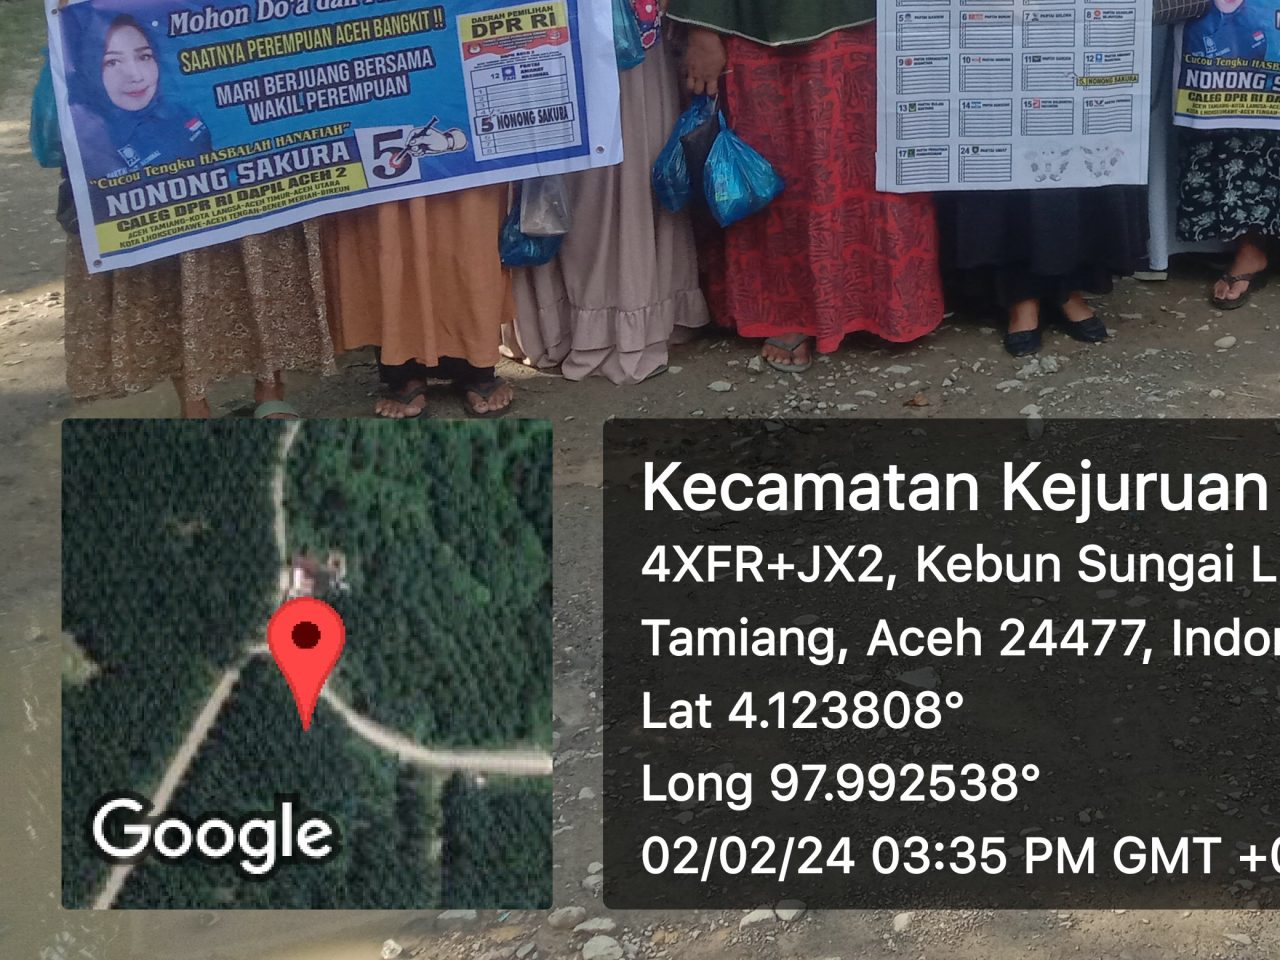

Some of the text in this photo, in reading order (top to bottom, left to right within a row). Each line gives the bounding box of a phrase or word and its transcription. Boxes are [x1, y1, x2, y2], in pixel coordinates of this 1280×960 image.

[169, 6, 249, 36] Mohon
[472, 5, 553, 24] DAERAH PEMILIHAN
[472, 12, 557, 38] DPR RI
[180, 46, 246, 73] SAATNYA
[248, 29, 332, 58] PEREMPUAN
[335, 21, 374, 44] ACEH
[376, 10, 430, 38] BANGKIT
[216, 48, 433, 107] MARI BERJUANG BERSAMA
[1186, 69, 1266, 90] NONONG
[249, 75, 409, 123] WAKIL PEREMPUAN
[1188, 92, 1221, 102] CALEG
[1224, 94, 1247, 102] DPR
[1251, 94, 1263, 102] RI
[481, 117, 494, 132] 5
[497, 111, 536, 130] NONONG
[144, 158, 196, 176] Tengku
[200, 139, 271, 165] HASBALAH
[372, 129, 412, 180] 5
[106, 141, 350, 217] NONONG SAKURA
[117, 167, 347, 232] CALEG DPR RI DAPIL ACEH 2
